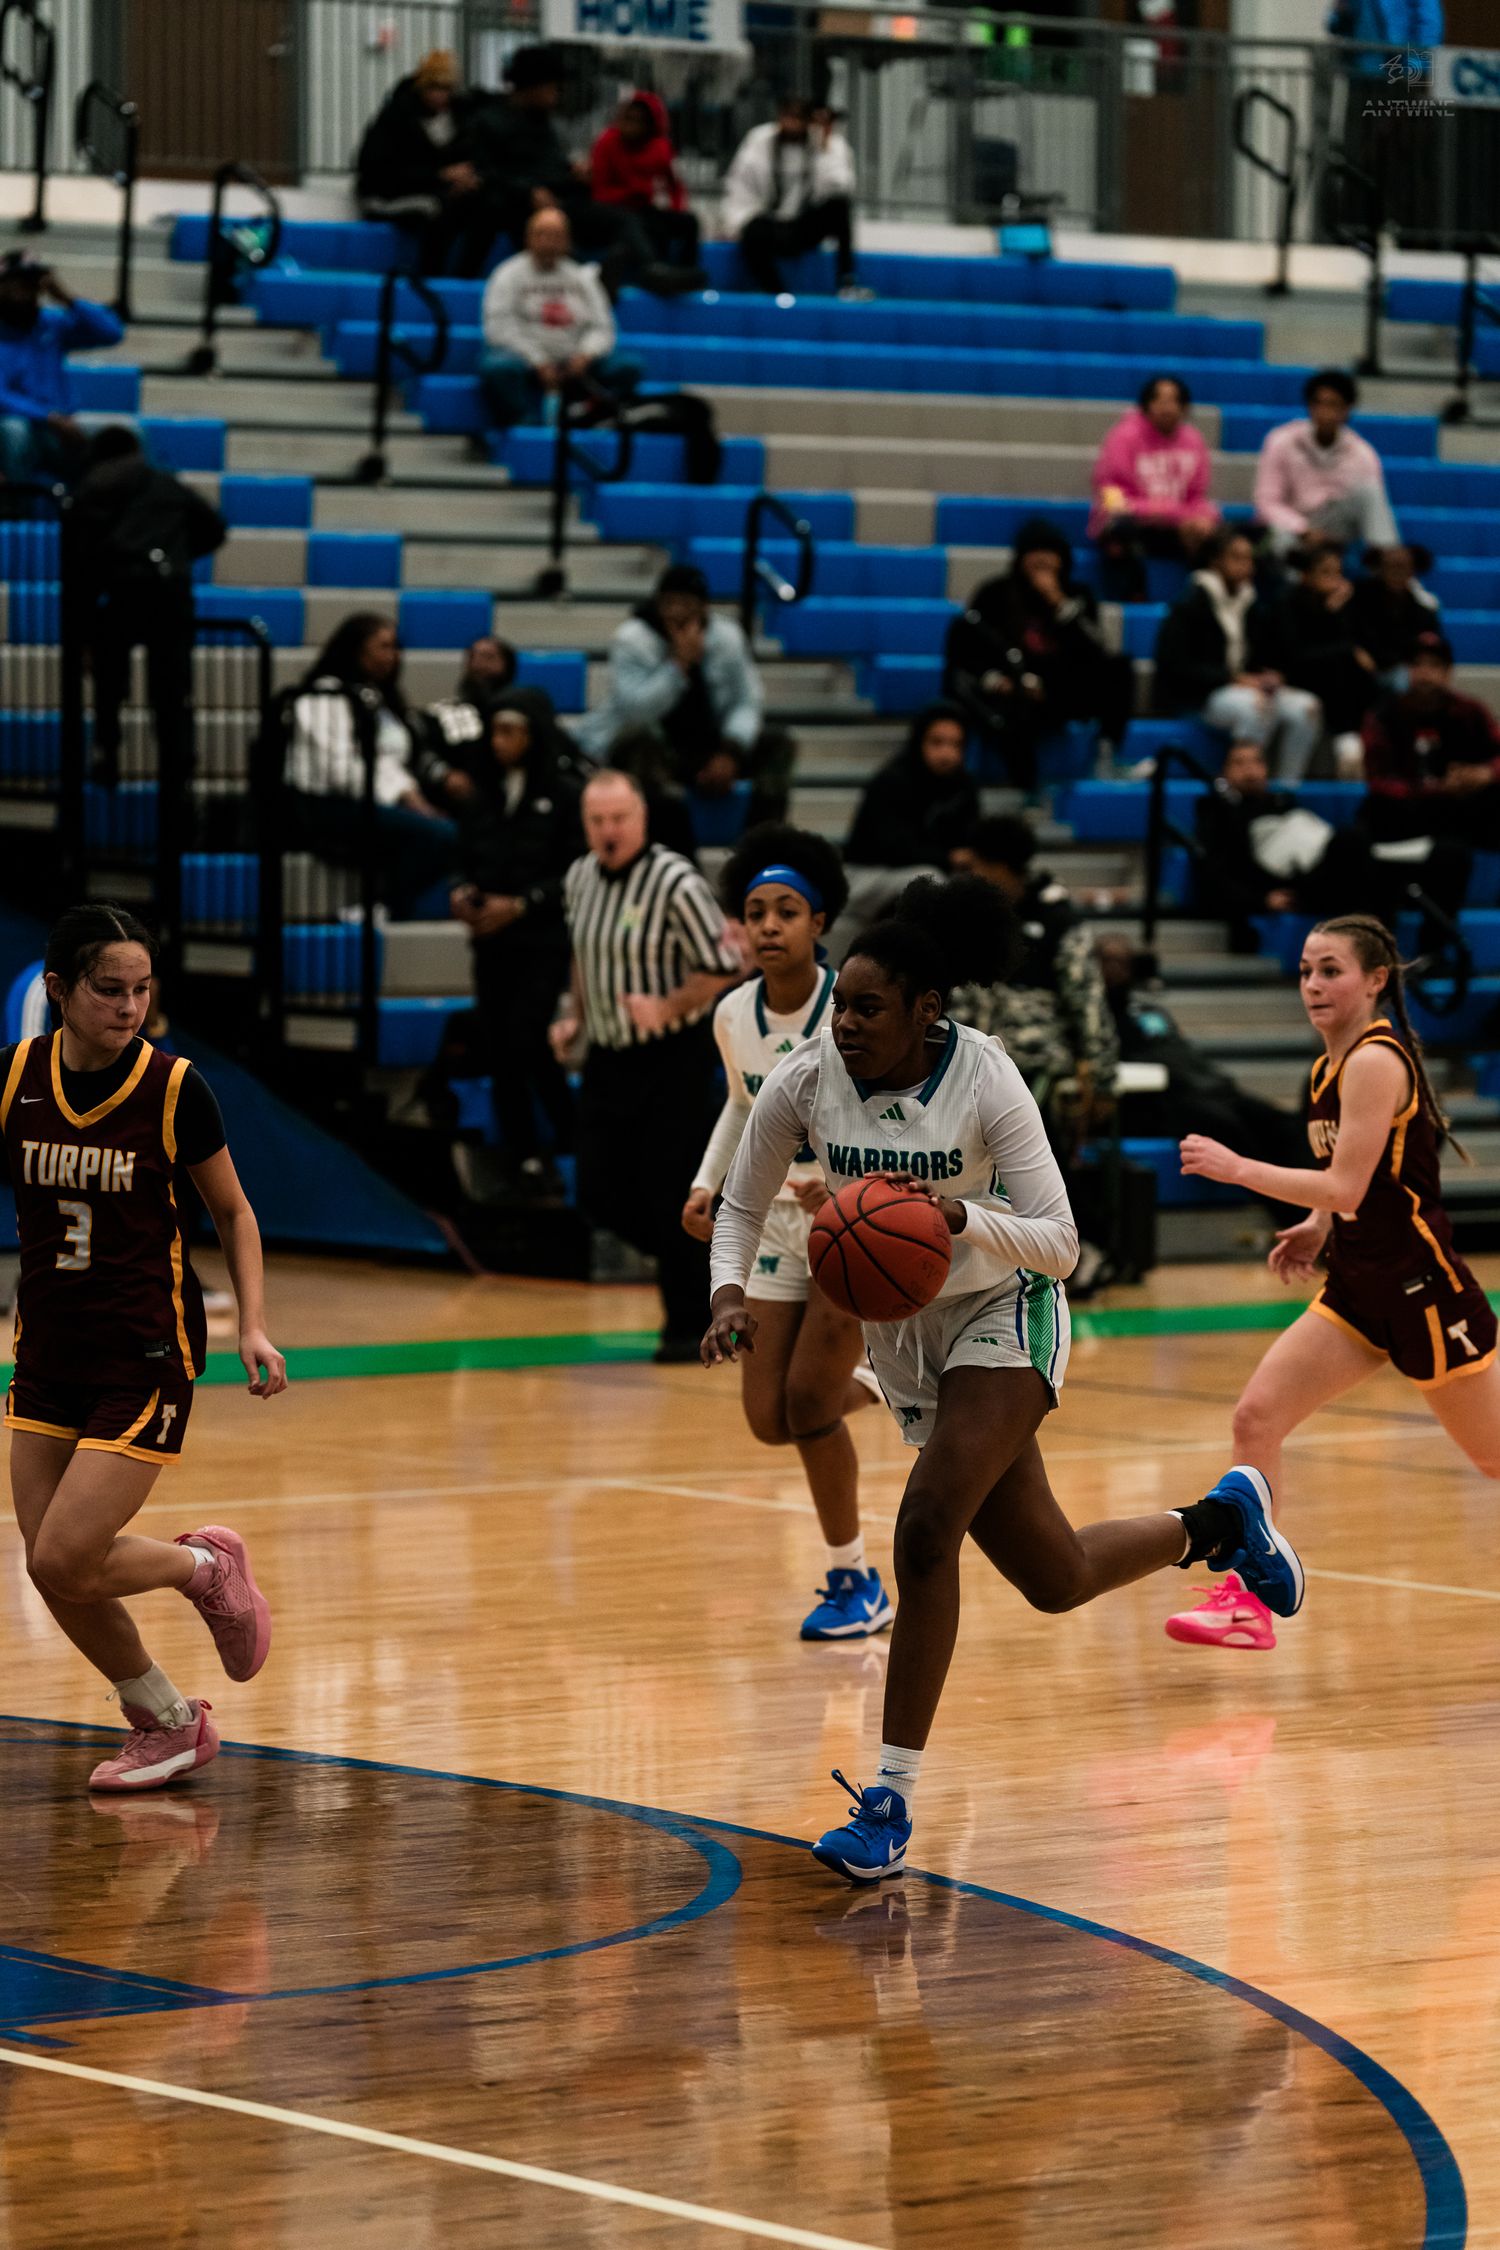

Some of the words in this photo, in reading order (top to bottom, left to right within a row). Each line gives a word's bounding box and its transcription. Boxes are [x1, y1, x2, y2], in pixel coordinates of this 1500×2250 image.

[576, 0, 711, 42] HOME
[22, 1140, 136, 1192] TURPIN
[827, 1142, 963, 1181] WARRIORS
[55, 1199, 93, 1271] 3
[1447, 1319, 1479, 1356] T
[156, 1404, 177, 1445] T
